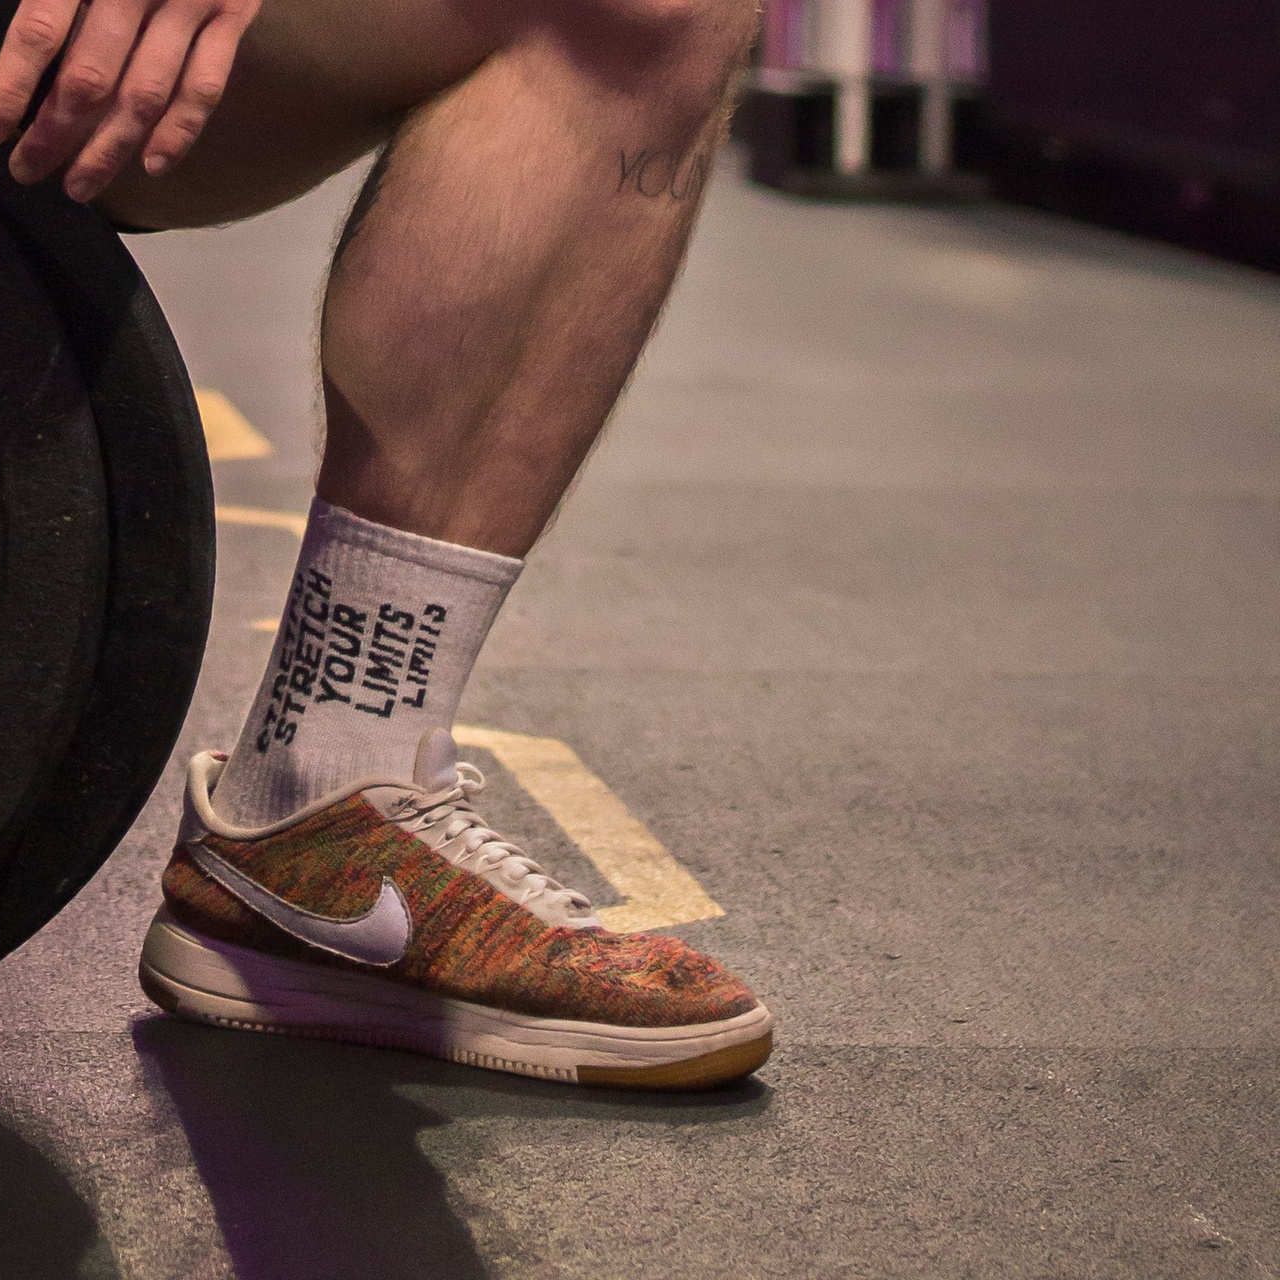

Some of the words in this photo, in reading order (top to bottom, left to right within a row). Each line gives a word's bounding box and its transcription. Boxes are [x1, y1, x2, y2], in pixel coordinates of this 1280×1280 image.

[274, 568, 334, 746] STRETCH
[314, 602, 368, 706] YOUR
[355, 602, 415, 719] LIMITS
